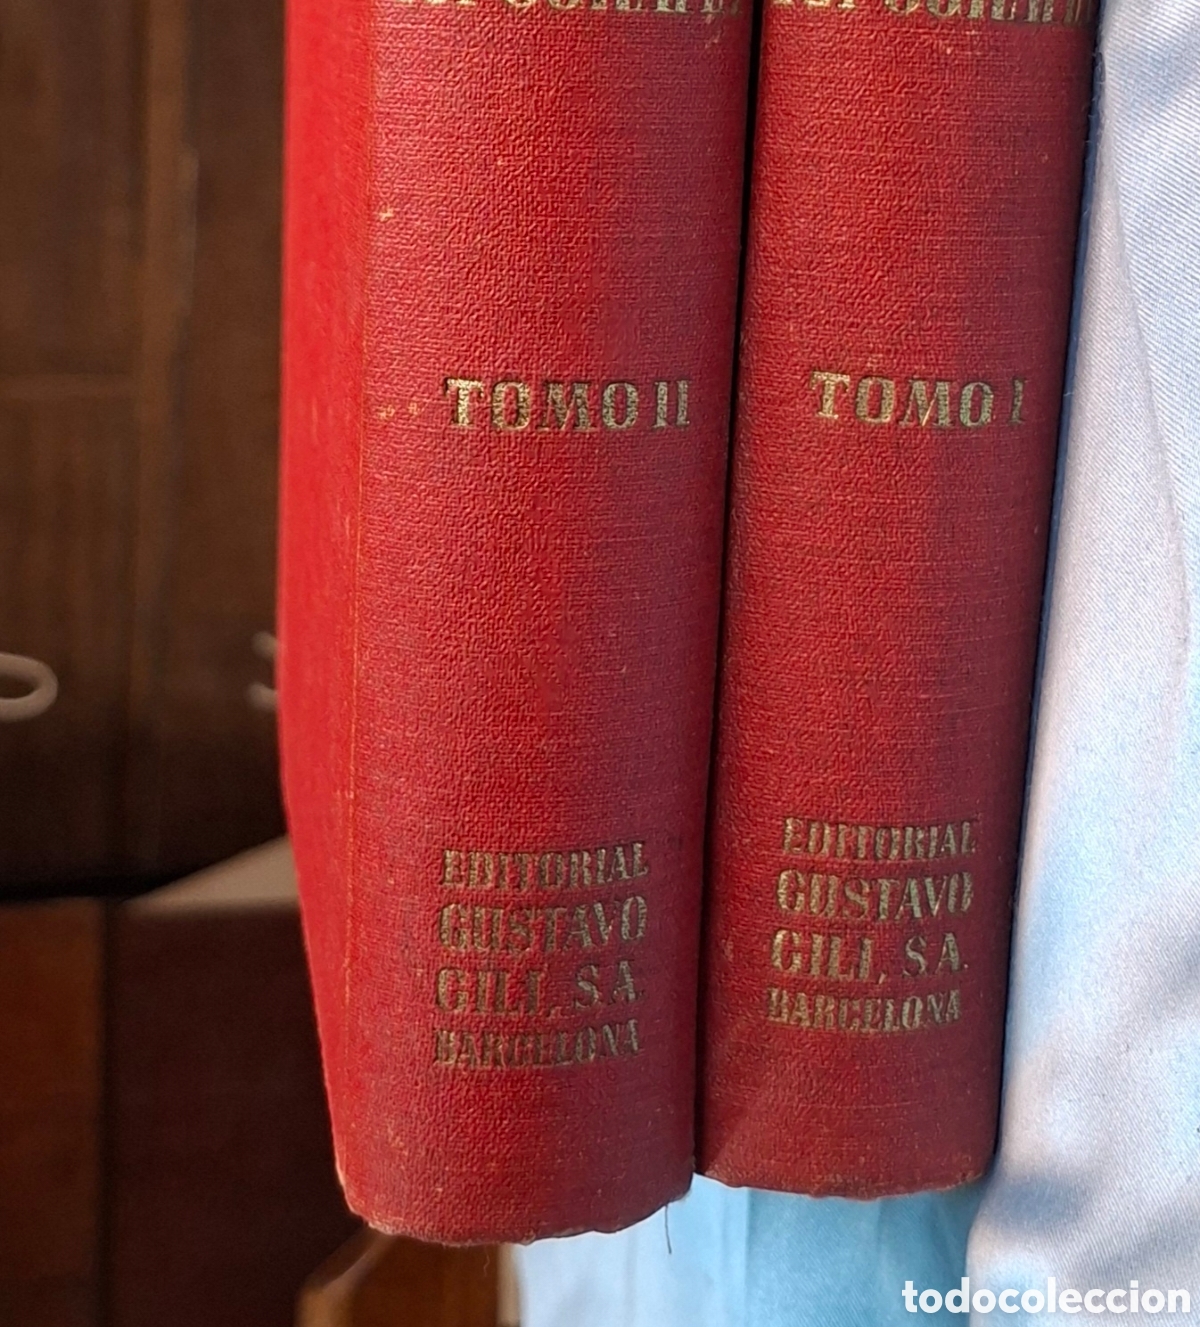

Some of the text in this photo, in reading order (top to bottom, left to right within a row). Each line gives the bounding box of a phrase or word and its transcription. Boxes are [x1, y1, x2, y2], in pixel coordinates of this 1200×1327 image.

[444, 377, 692, 432] TOMO II
[811, 370, 1027, 428] TOMO I
[783, 816, 978, 861] EDITORIAL
[439, 841, 649, 891] EDITORIAL
[776, 868, 975, 921] GUSTAVO
[438, 894, 648, 954] GUSTAVO
[767, 987, 961, 1033] BARCELONA
[433, 1018, 642, 1067] BARCELONA
